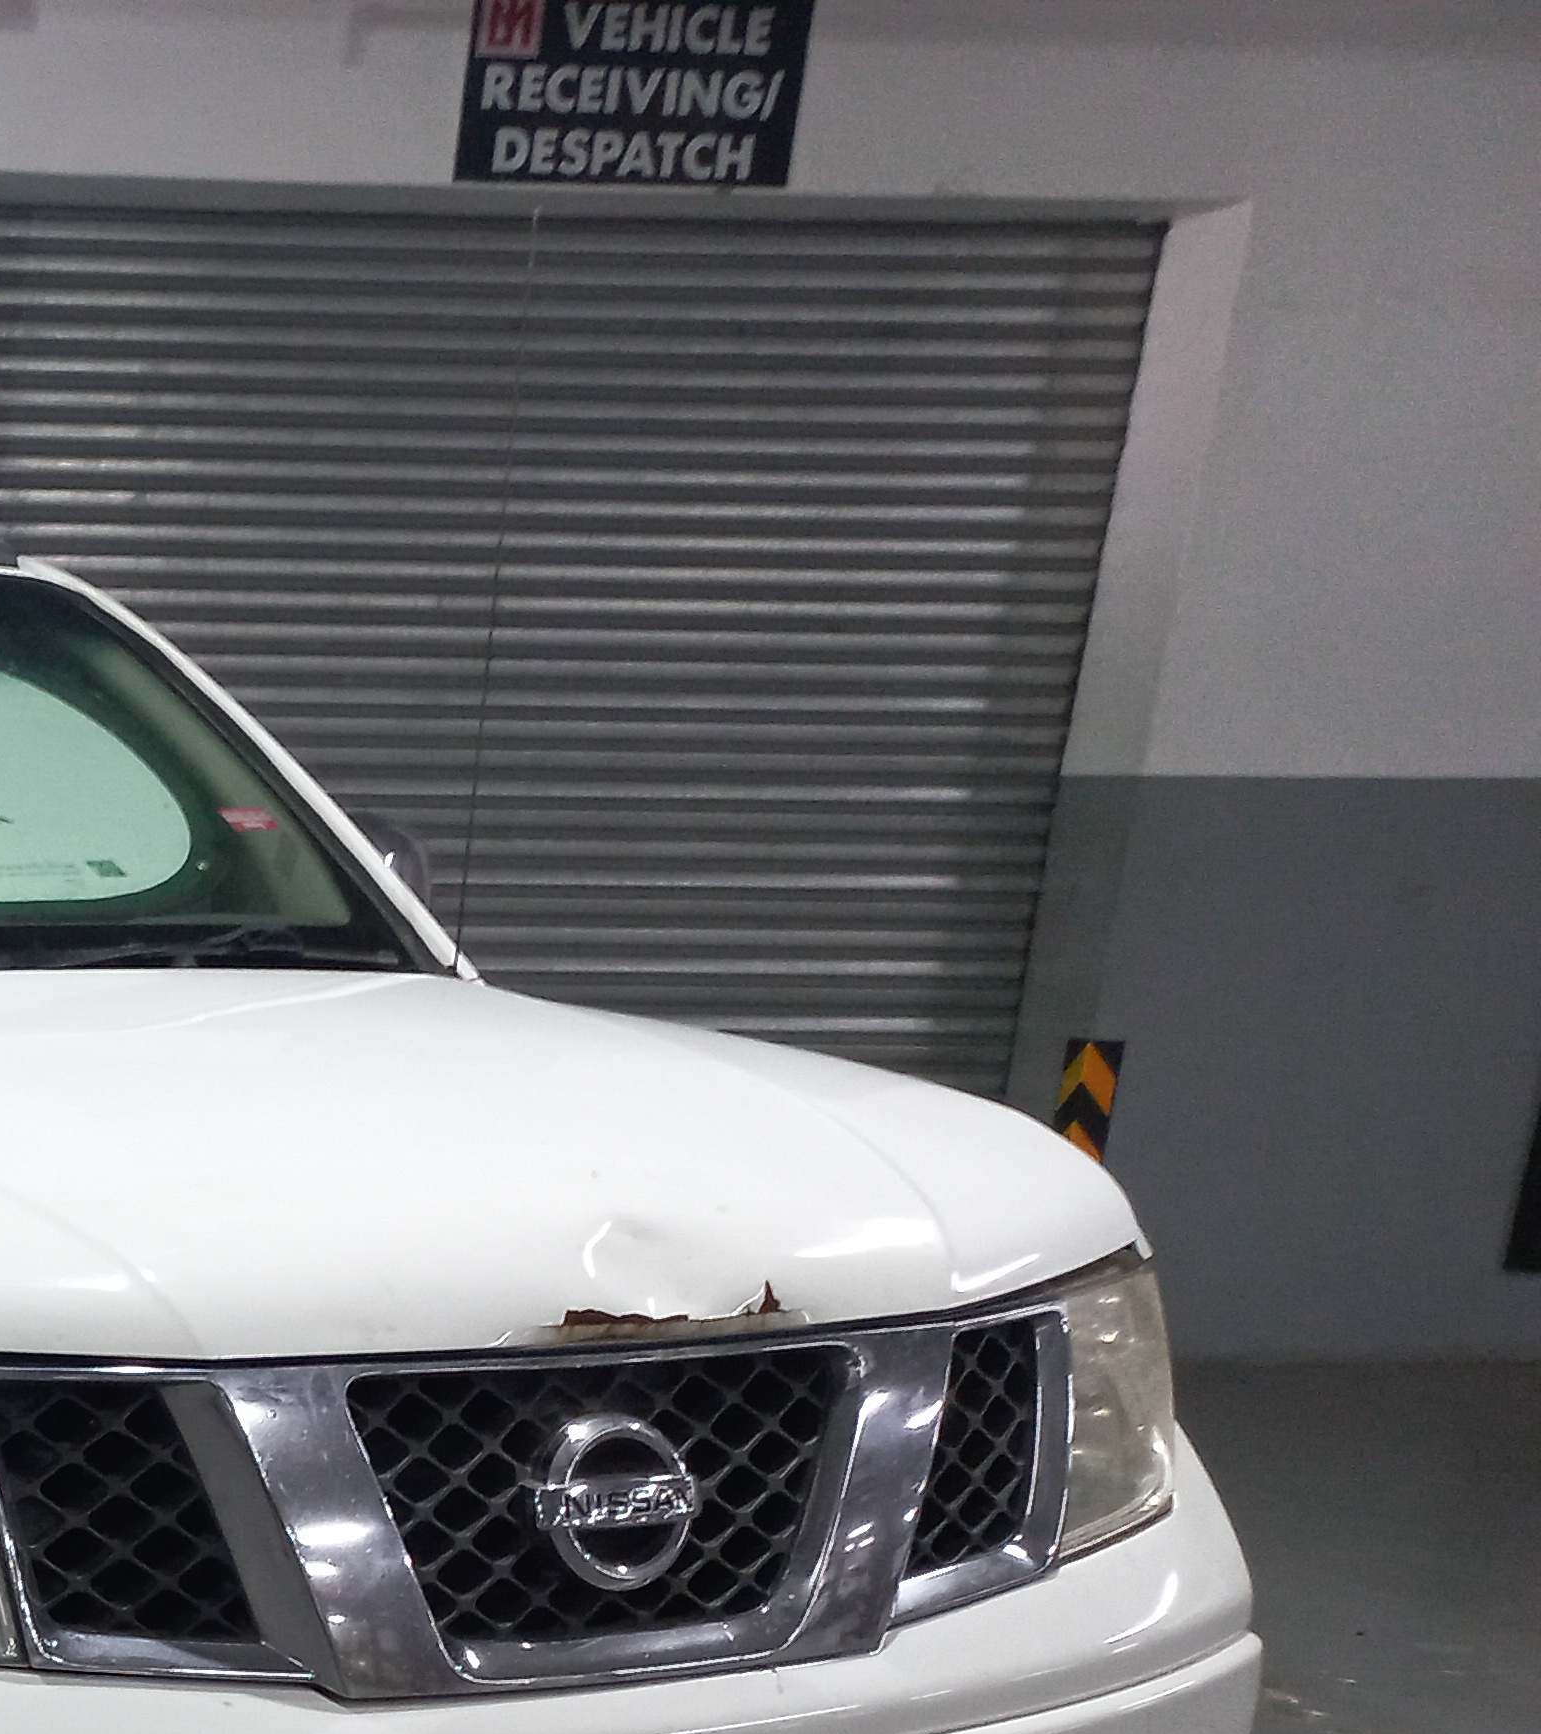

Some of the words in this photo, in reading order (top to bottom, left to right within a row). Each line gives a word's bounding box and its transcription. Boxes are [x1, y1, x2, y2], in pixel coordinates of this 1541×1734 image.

[566, 3, 776, 56] VEHICLE
[481, 61, 786, 121] RECEIVING/
[491, 125, 757, 180] DESPATCH
